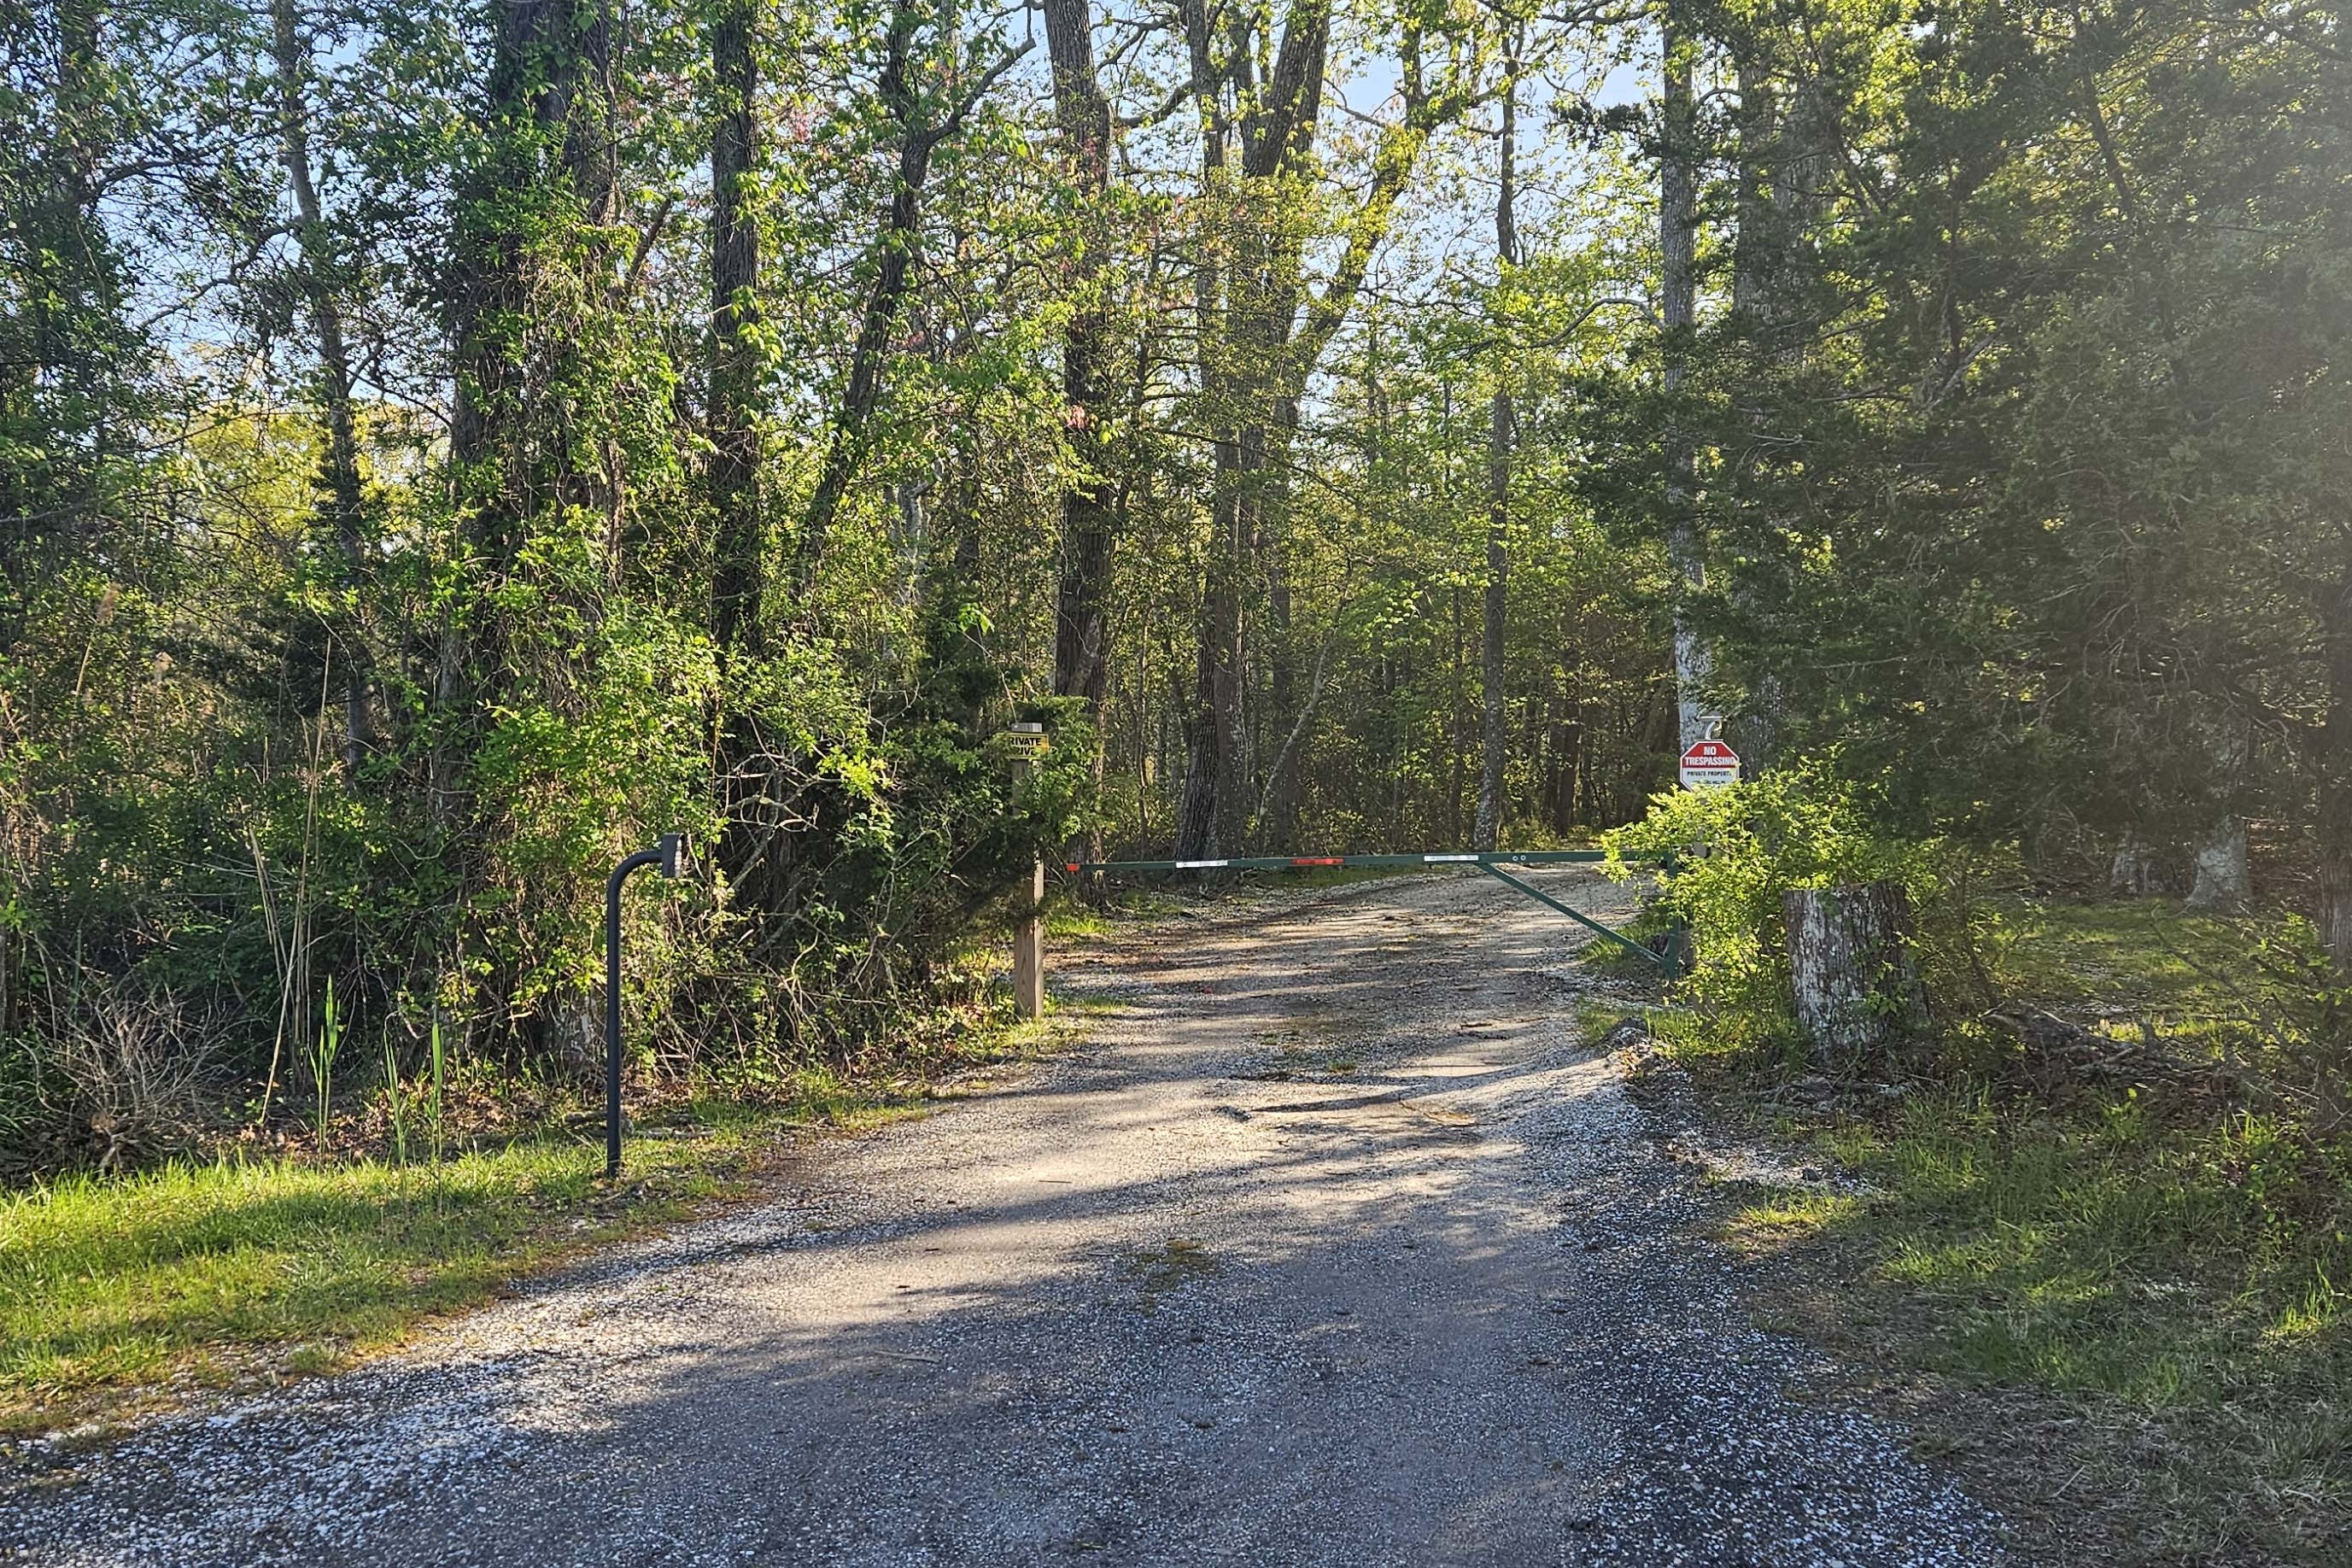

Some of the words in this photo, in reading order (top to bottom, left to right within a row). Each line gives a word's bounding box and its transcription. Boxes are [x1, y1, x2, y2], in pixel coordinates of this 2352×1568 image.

[1006, 736, 1042, 746] RIVATE
[1703, 746, 1717, 756] NO
[1685, 757, 1735, 766] TRESPASSING
